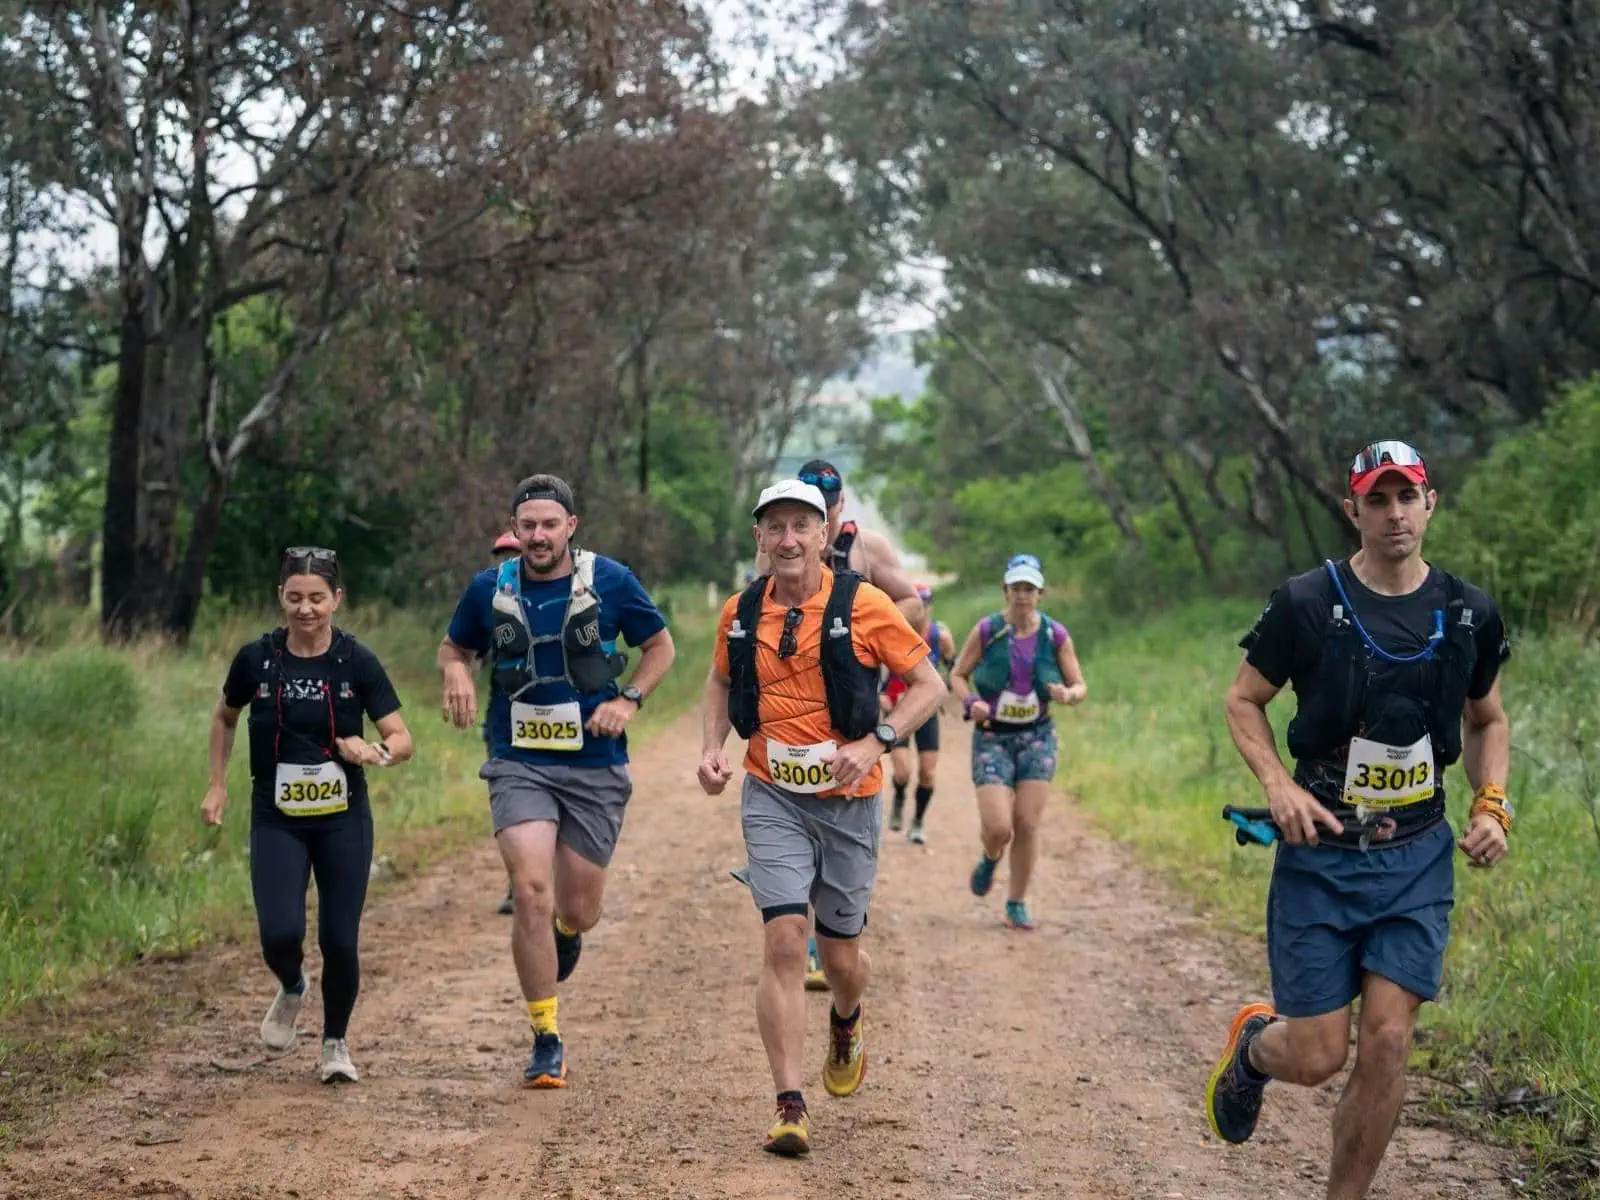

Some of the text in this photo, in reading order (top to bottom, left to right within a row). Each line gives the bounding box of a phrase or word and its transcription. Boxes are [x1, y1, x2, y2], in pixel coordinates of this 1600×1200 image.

[516, 720, 578, 739] 33025
[1354, 761, 1428, 791] 33013
[280, 779, 343, 802] 33024
